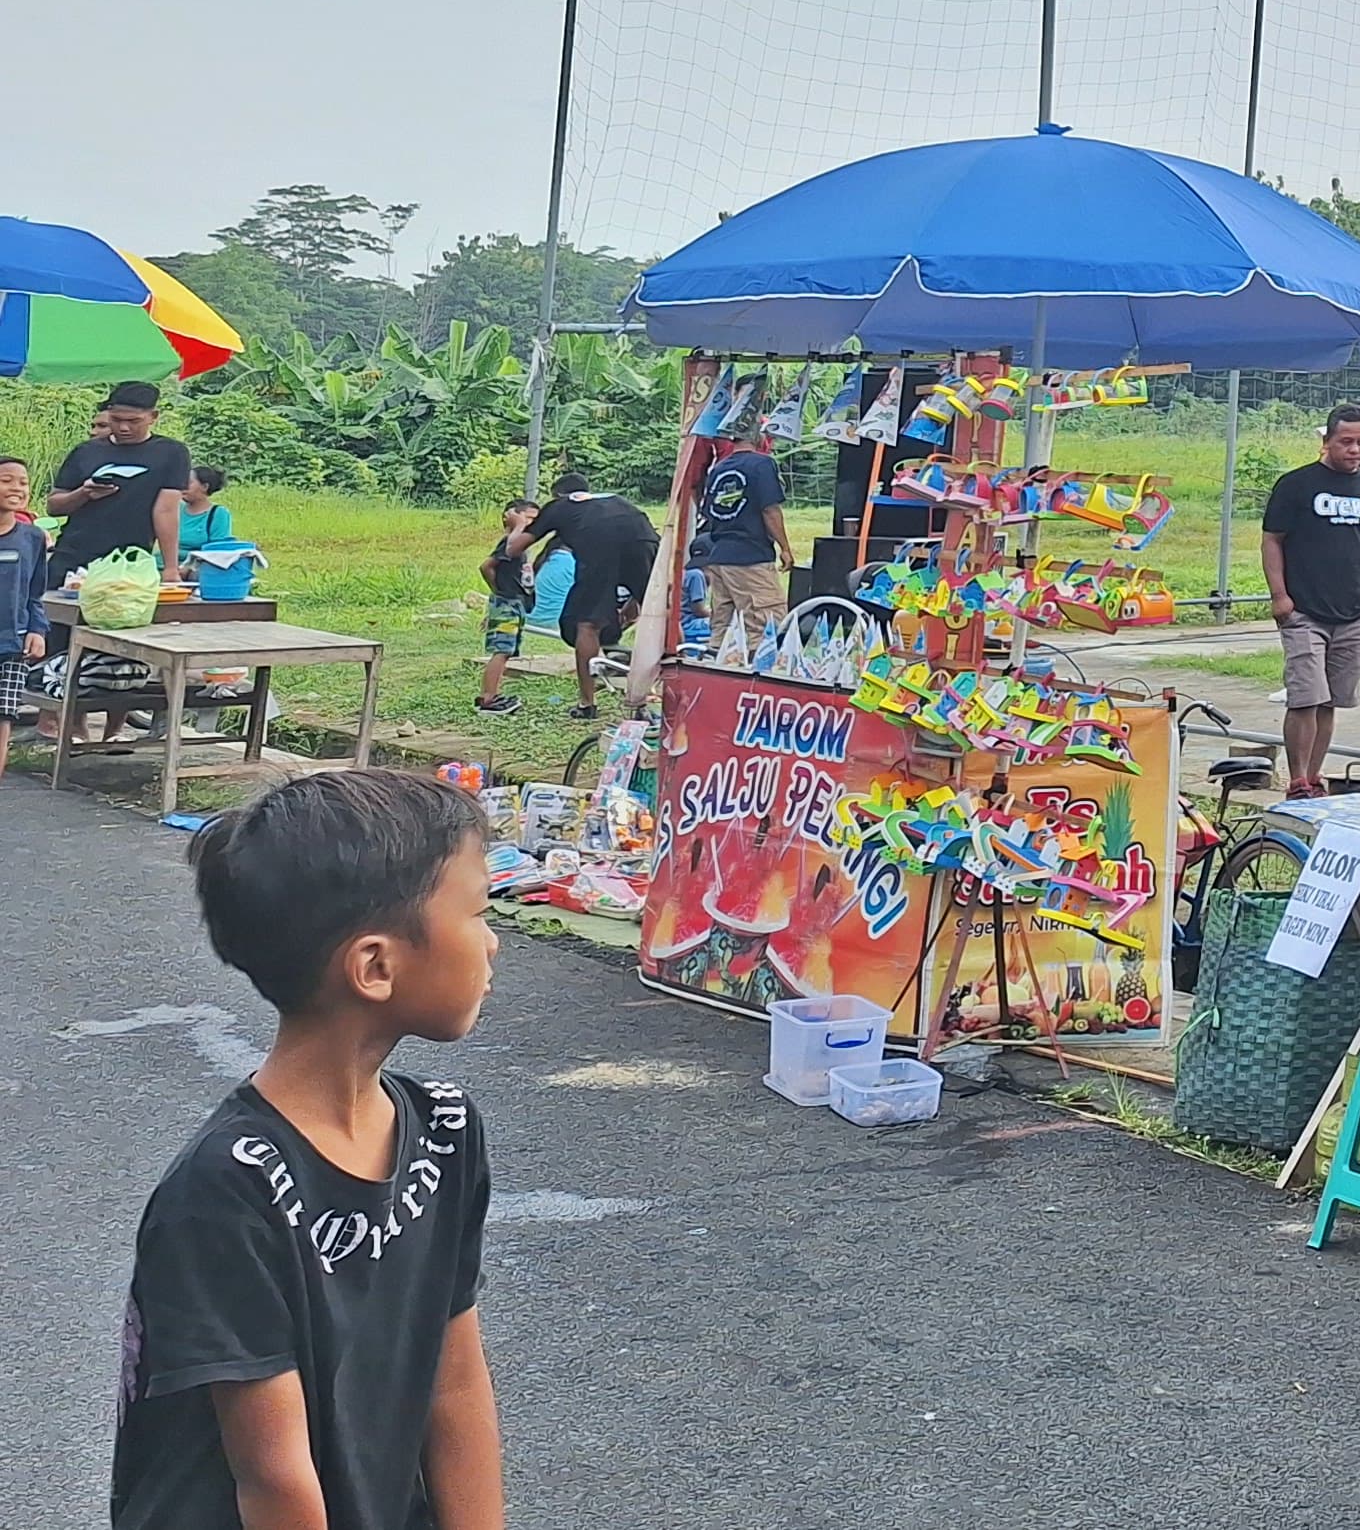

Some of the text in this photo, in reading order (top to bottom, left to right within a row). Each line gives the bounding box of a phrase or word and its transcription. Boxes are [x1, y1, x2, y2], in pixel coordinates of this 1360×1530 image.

[733, 692, 855, 762] TAROM
[677, 756, 782, 836] SALJU
[782, 761, 909, 940] PELNGI
